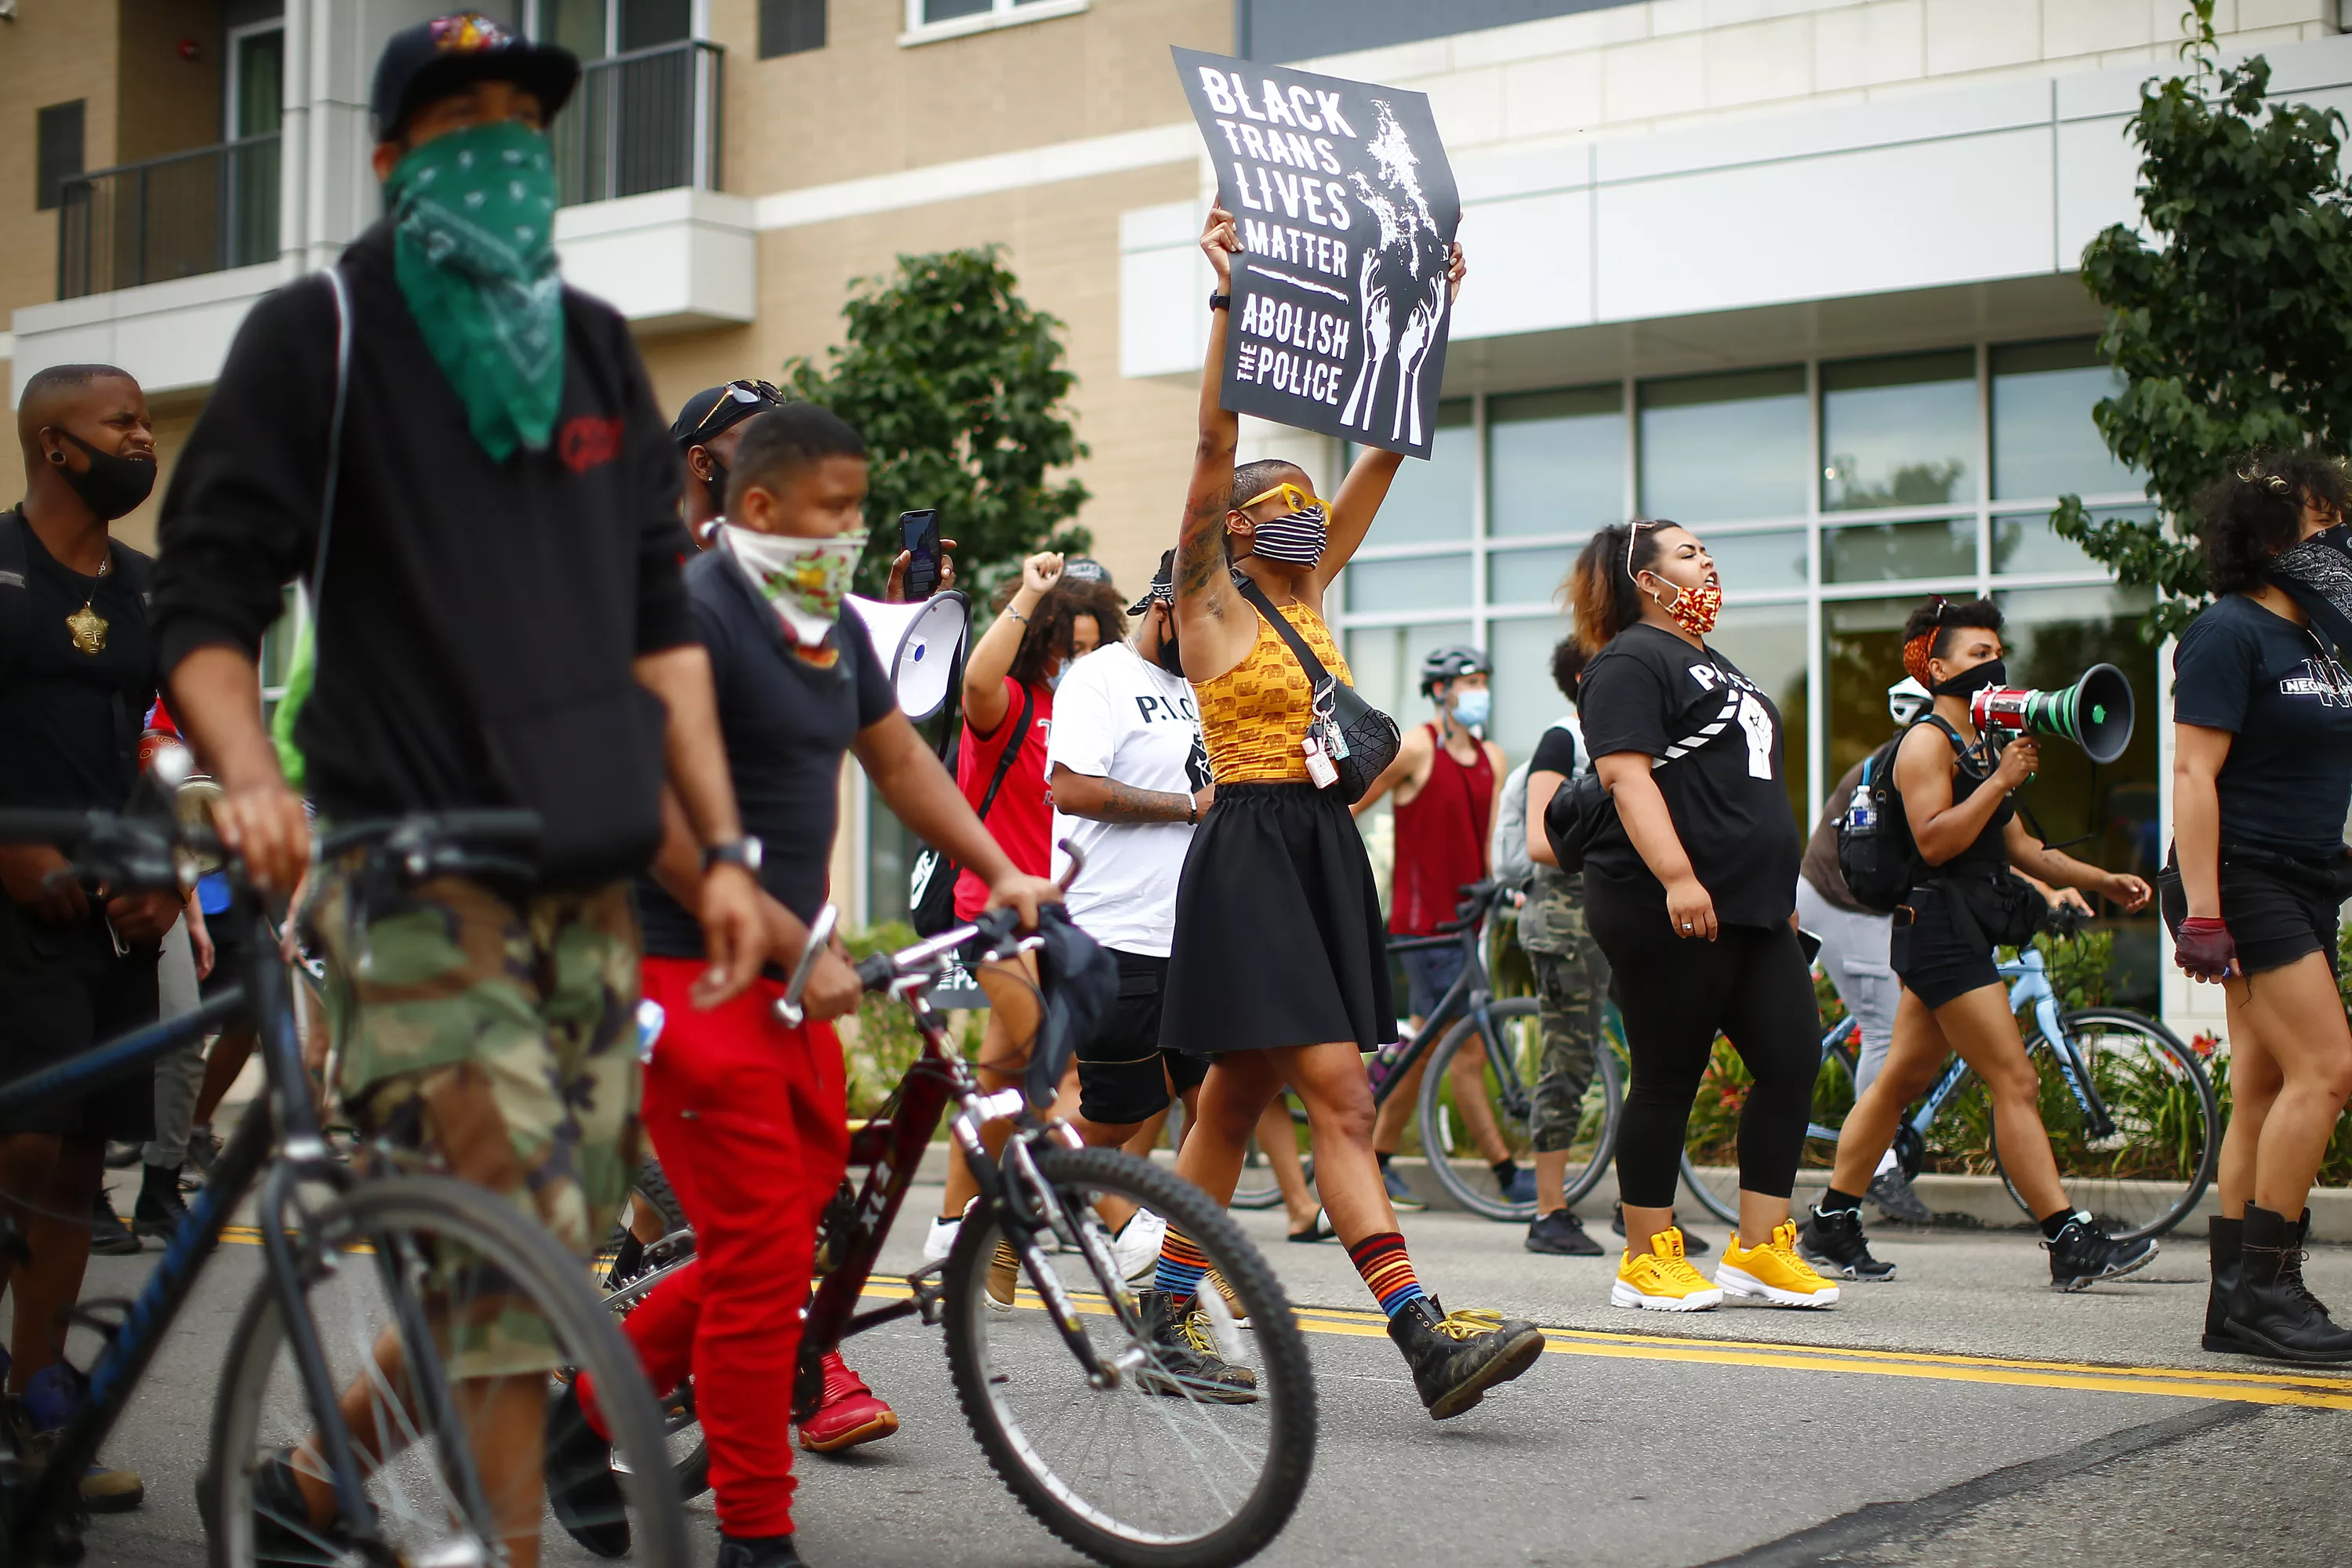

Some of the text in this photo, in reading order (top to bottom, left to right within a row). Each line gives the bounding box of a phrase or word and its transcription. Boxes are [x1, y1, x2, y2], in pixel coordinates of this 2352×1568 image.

[1198, 66, 1357, 139] BLACK
[1216, 118, 1341, 176] TRANS
[1233, 162, 1351, 231] LIVES
[1243, 219, 1347, 278] MATTER
[1240, 292, 1350, 360] ABOLISH
[1236, 341, 1343, 405] THE POLICE
